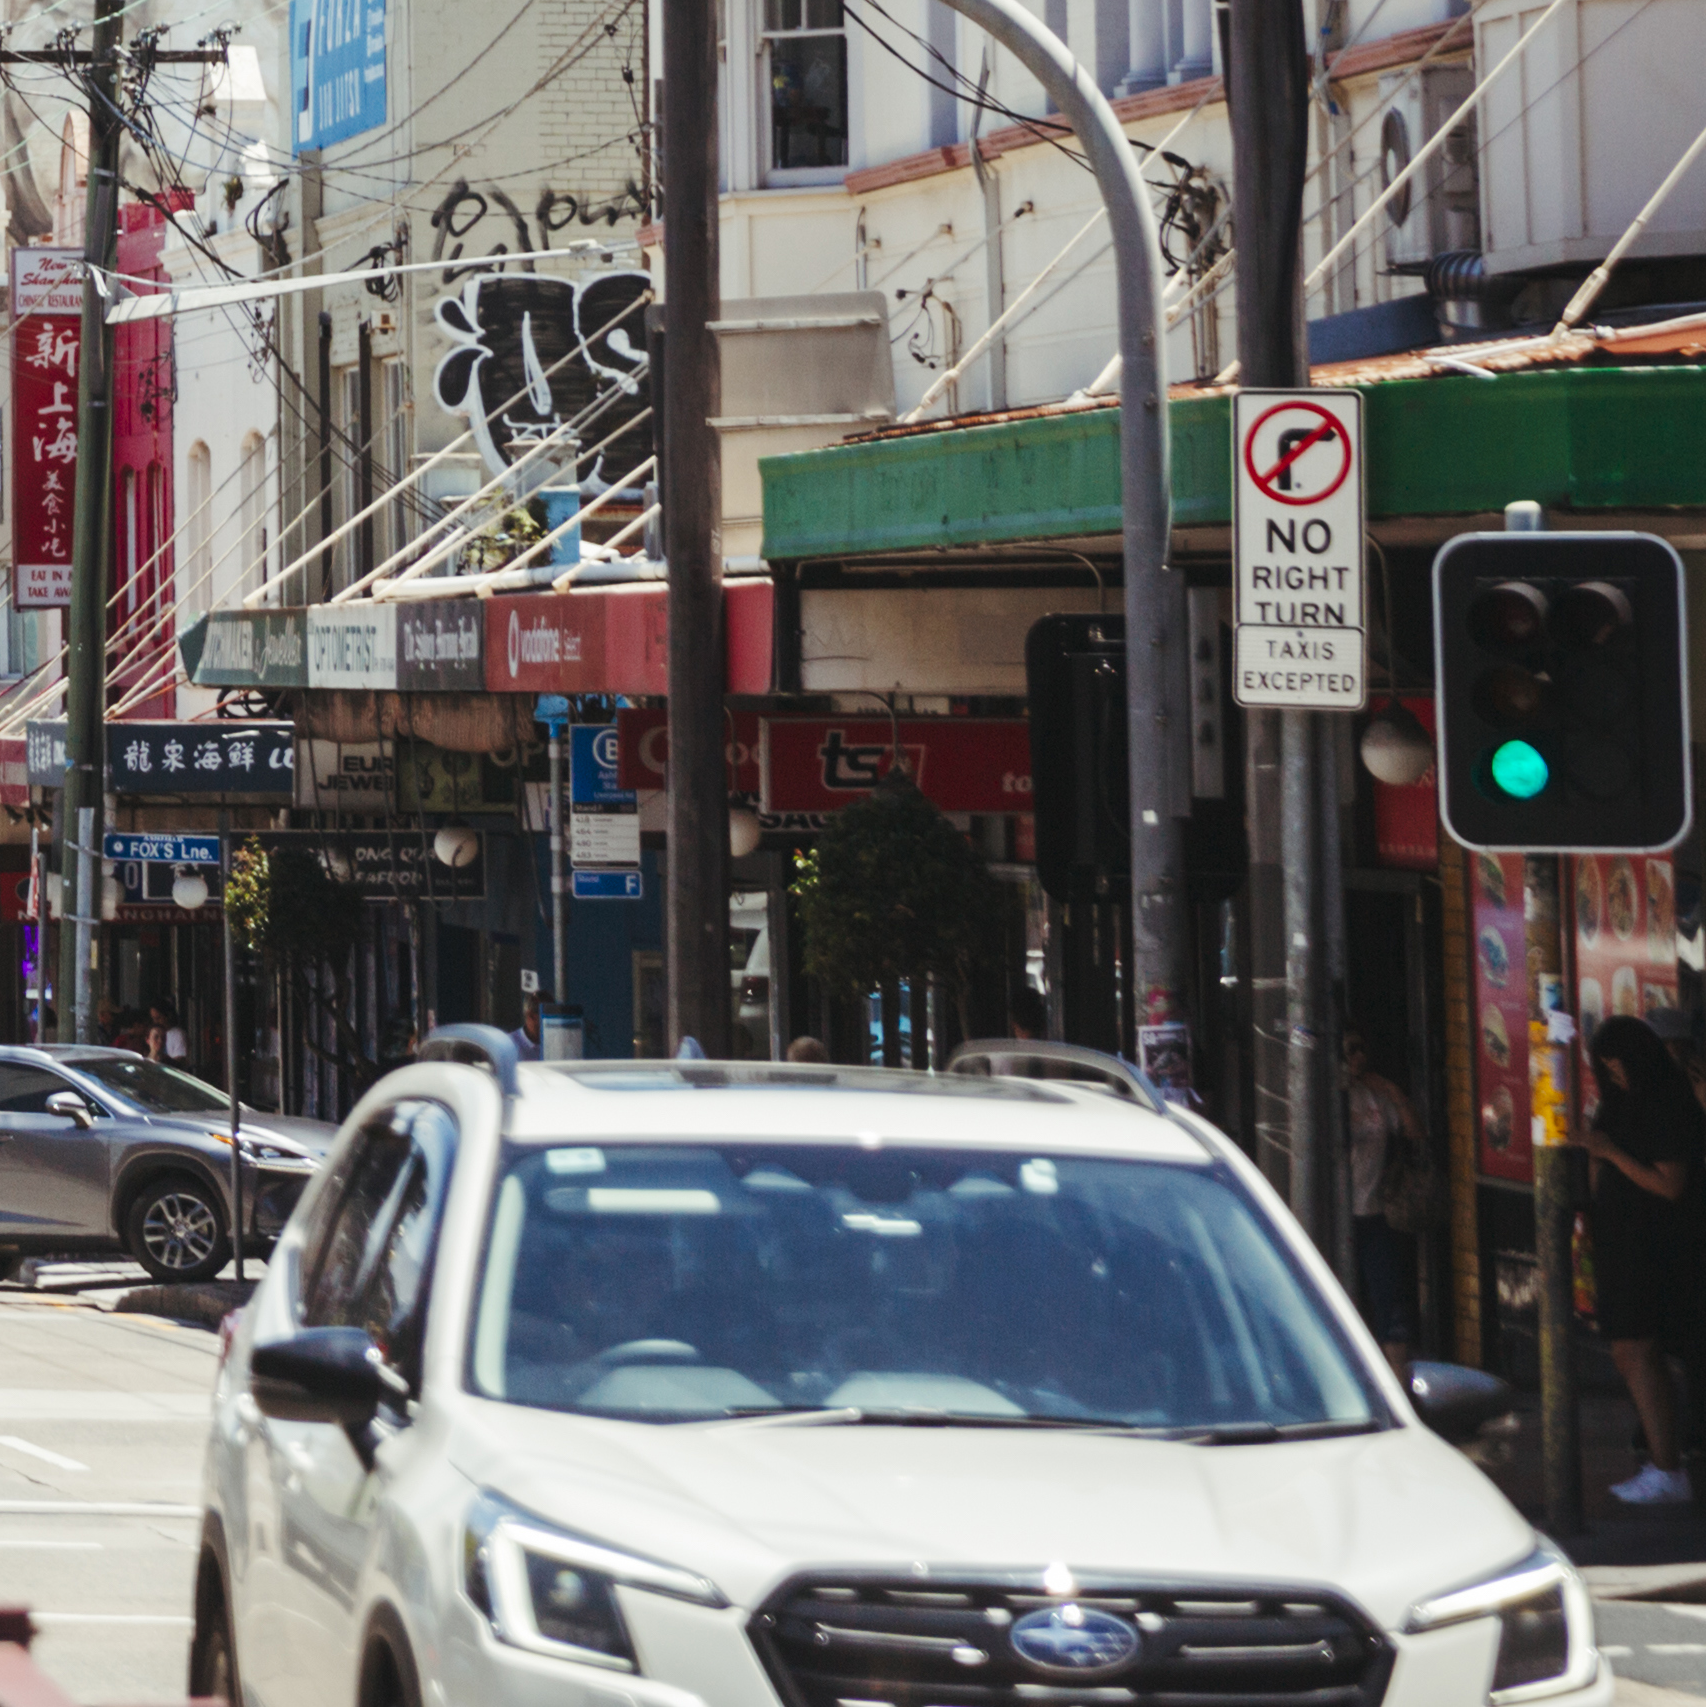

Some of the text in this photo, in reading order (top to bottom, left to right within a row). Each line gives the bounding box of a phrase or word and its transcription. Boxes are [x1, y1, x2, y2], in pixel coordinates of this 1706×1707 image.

[39, 257, 67, 272] New
[26, 322, 79, 464] 新上海
[41, 469, 66, 557] 美食小吃
[1267, 518, 1332, 554] NO
[32, 571, 63, 581] EAT IN
[1252, 566, 1350, 590] RIGHT
[27, 587, 48, 598] TAKE
[1254, 601, 1344, 625] TURN
[315, 625, 377, 672] OPTOMETRIST
[521, 616, 560, 663] vodafone
[1266, 640, 1335, 660] TAXIS
[1243, 671, 1356, 693] EXCEPTED
[124, 740, 255, 774] 龍泉海鮮
[344, 756, 393, 772] EUR
[130, 842, 212, 860] FOX'S Lne.
[625, 875, 636, 893] F
